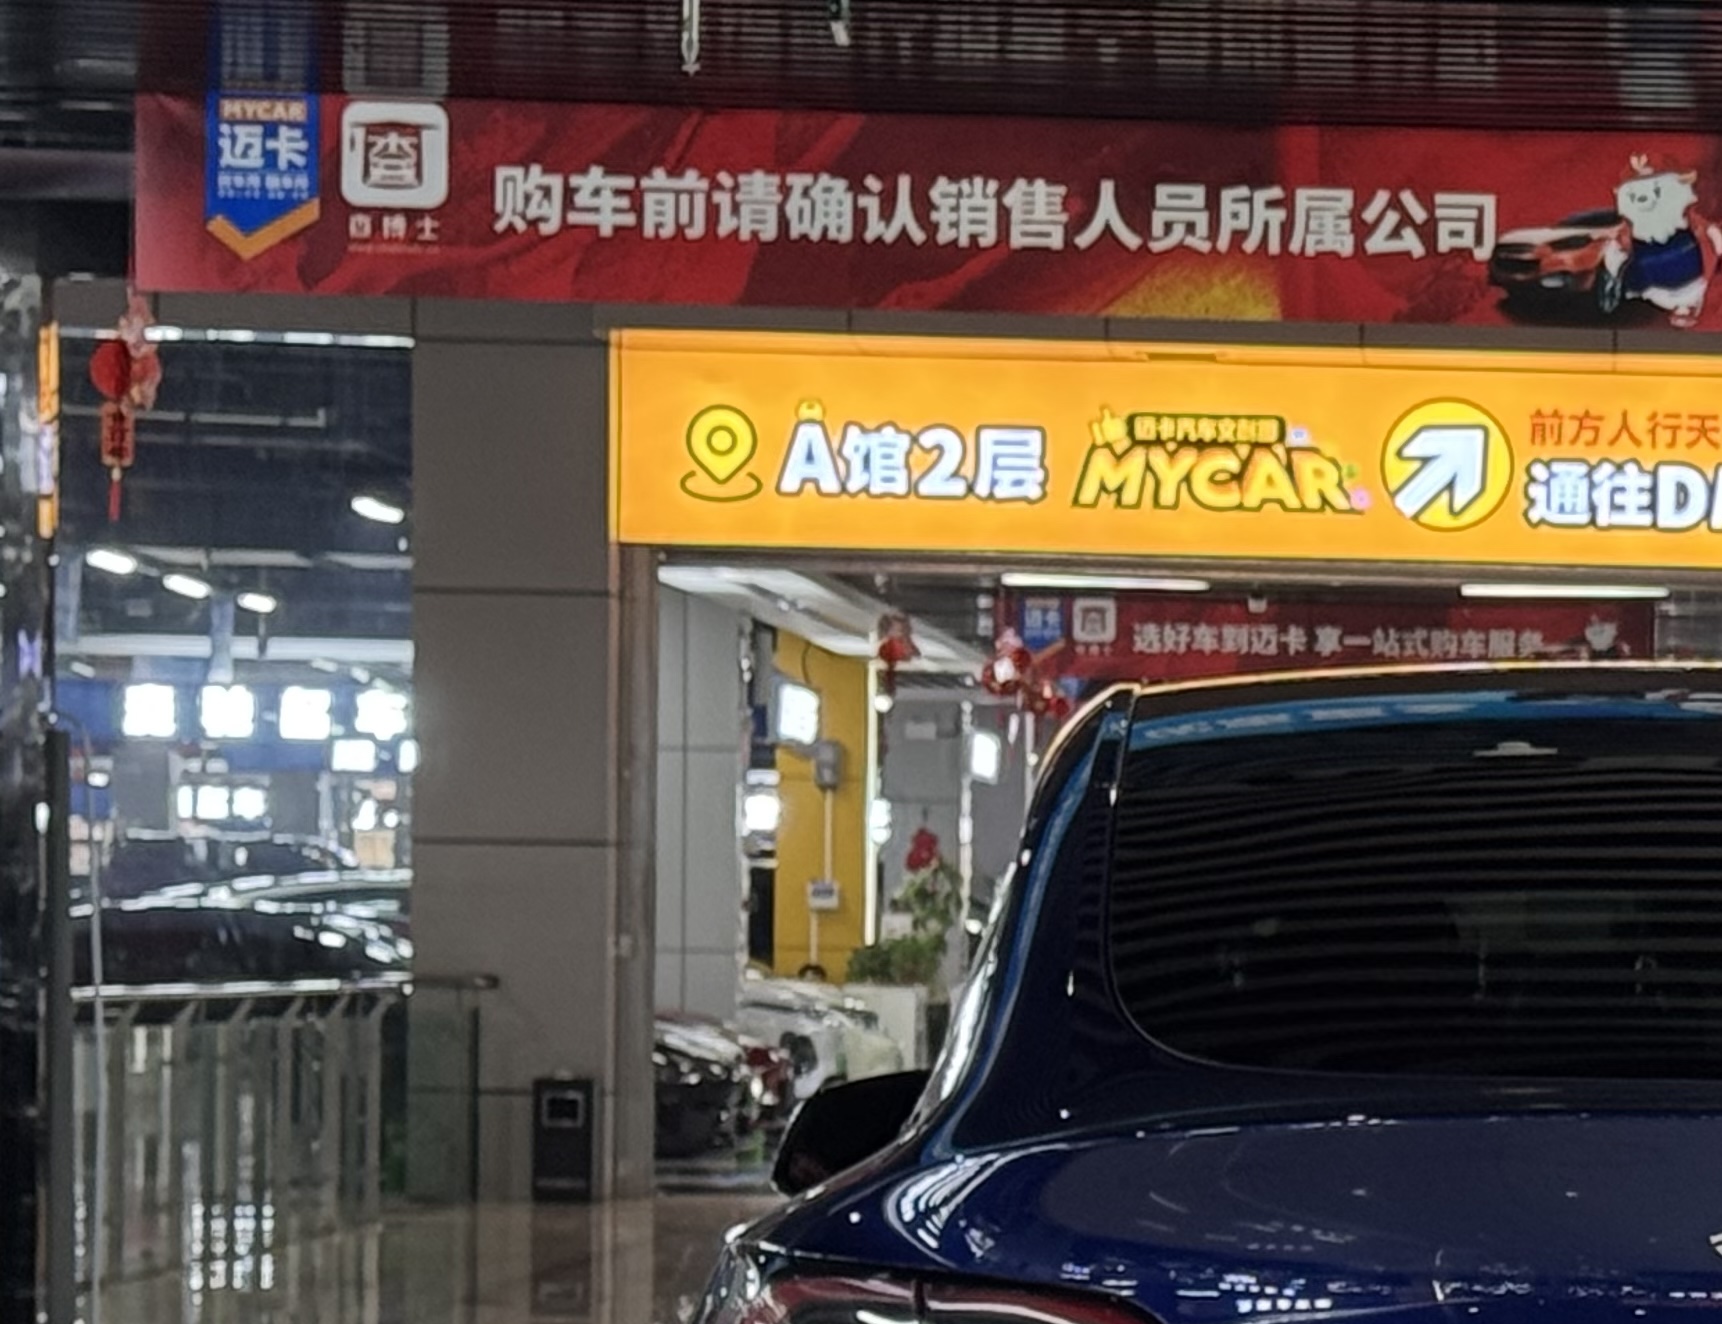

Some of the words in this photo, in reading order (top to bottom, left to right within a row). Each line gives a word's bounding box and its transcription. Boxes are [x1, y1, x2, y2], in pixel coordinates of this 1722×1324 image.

[220, 100, 307, 121] MYCAR
[217, 123, 309, 170] 迈卡
[493, 164, 1497, 262] 购车前请确认销售人员所属公司
[776, 418, 1048, 504] A馆2层
[1070, 443, 1362, 514] MYCAR
